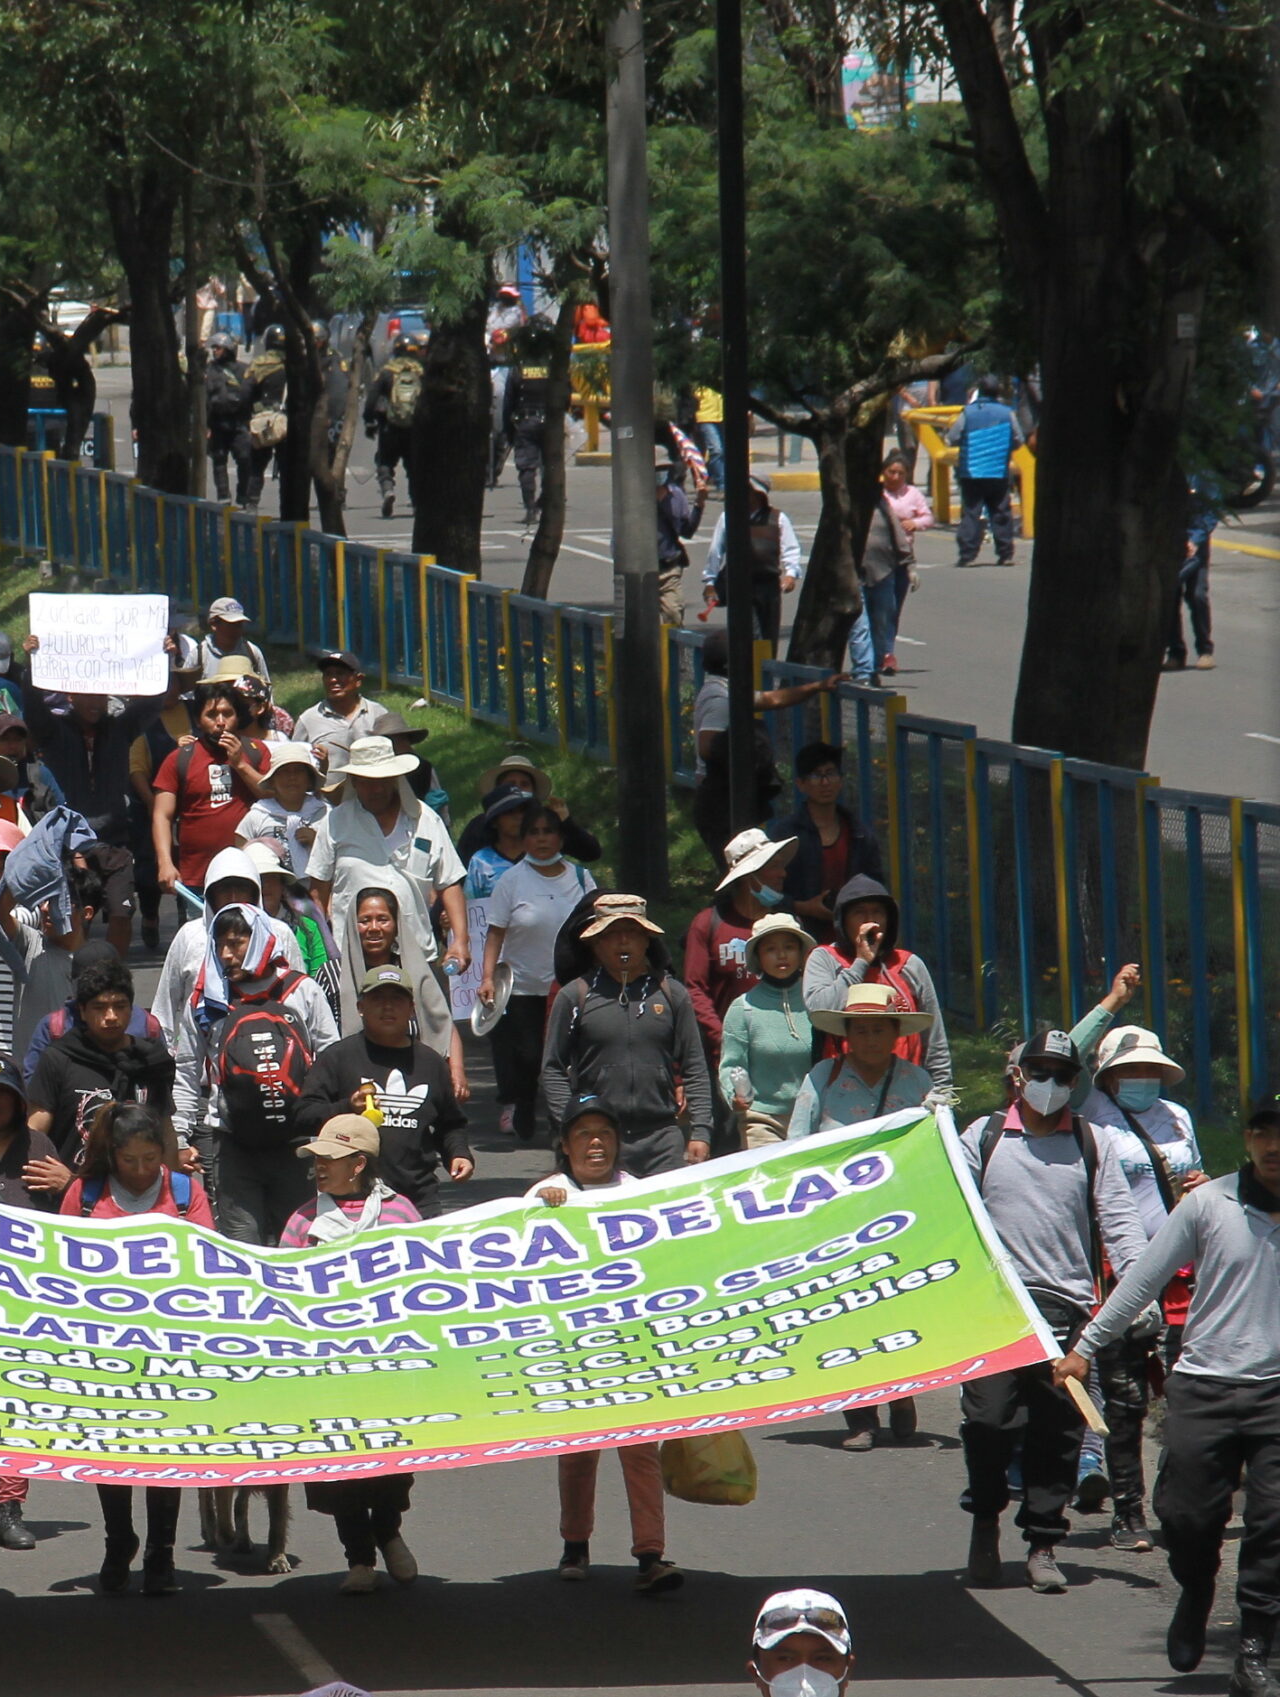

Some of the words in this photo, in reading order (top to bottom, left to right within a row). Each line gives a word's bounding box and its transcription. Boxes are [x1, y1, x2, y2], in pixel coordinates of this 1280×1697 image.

[59, 1233, 176, 1278] DE
[193, 1222, 582, 1297] DEFENSA
[594, 1197, 716, 1254] DE
[446, 1316, 552, 1351] DE
[563, 1286, 704, 1332] RIO
[718, 1212, 911, 1296] SECO
[513, 1329, 641, 1358] C.C.
[644, 1251, 900, 1337] Bonanza
[520, 1351, 647, 1379] C.C.
[764, 1258, 960, 1335] Robles
[1, 1368, 218, 1402] Camilo
[141, 1356, 438, 1383] Mayorista
[523, 1361, 698, 1397] Block
[532, 1391, 653, 1413] Sub
[657, 1366, 798, 1398] Lote
[817, 1329, 924, 1370] 2-B
[7, 1417, 218, 1441] Miguel
[223, 1421, 306, 1437] de
[309, 1412, 463, 1434] Ilave
[46, 1431, 357, 1462] Municipal
[230, 1460, 387, 1484] para
[394, 1450, 472, 1468] un
[483, 1413, 756, 1457] desarrollo
